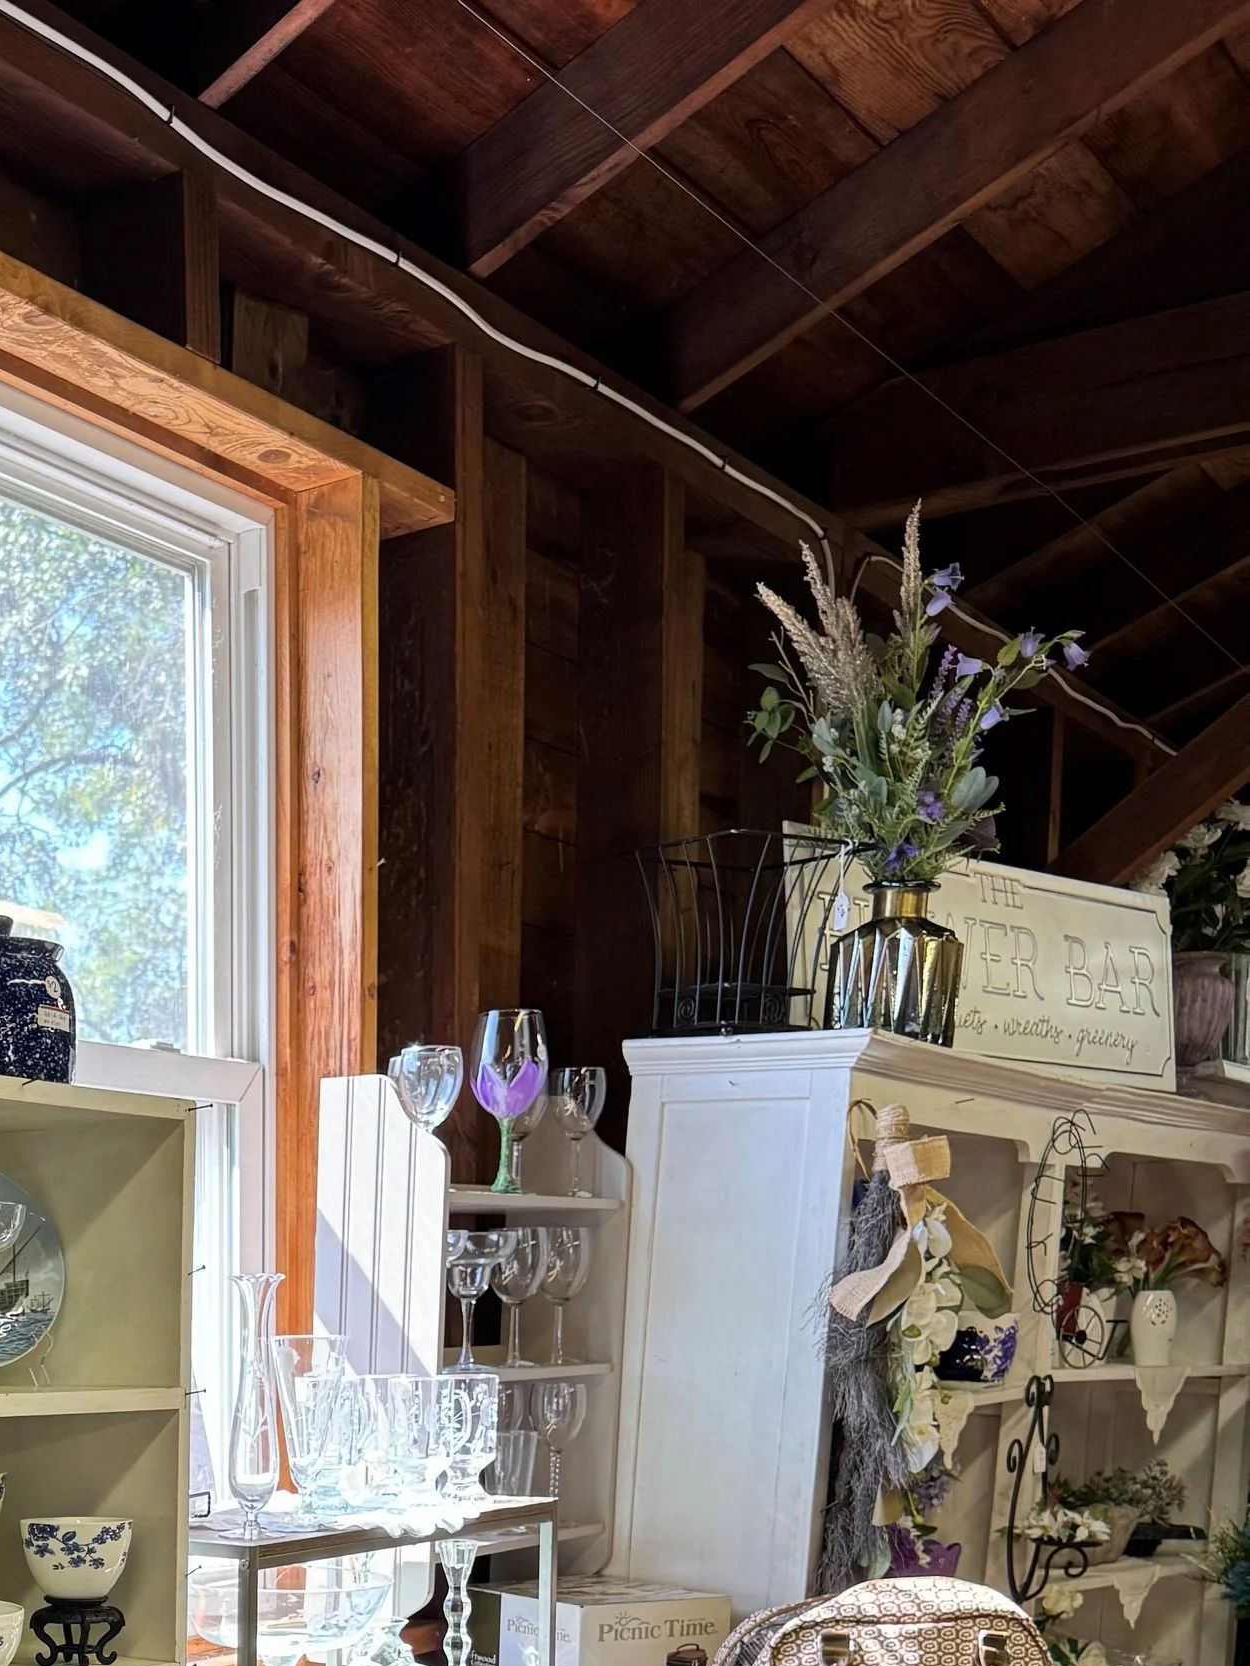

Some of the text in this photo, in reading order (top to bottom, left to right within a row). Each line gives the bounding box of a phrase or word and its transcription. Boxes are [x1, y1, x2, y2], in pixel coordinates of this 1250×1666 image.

[972, 871, 1024, 910] THE
[1062, 934, 1161, 1018] BAR
[1003, 1014, 1064, 1045] wreaths
[1076, 1027, 1139, 1066] greenery
[597, 1622, 662, 1643] Picnic
